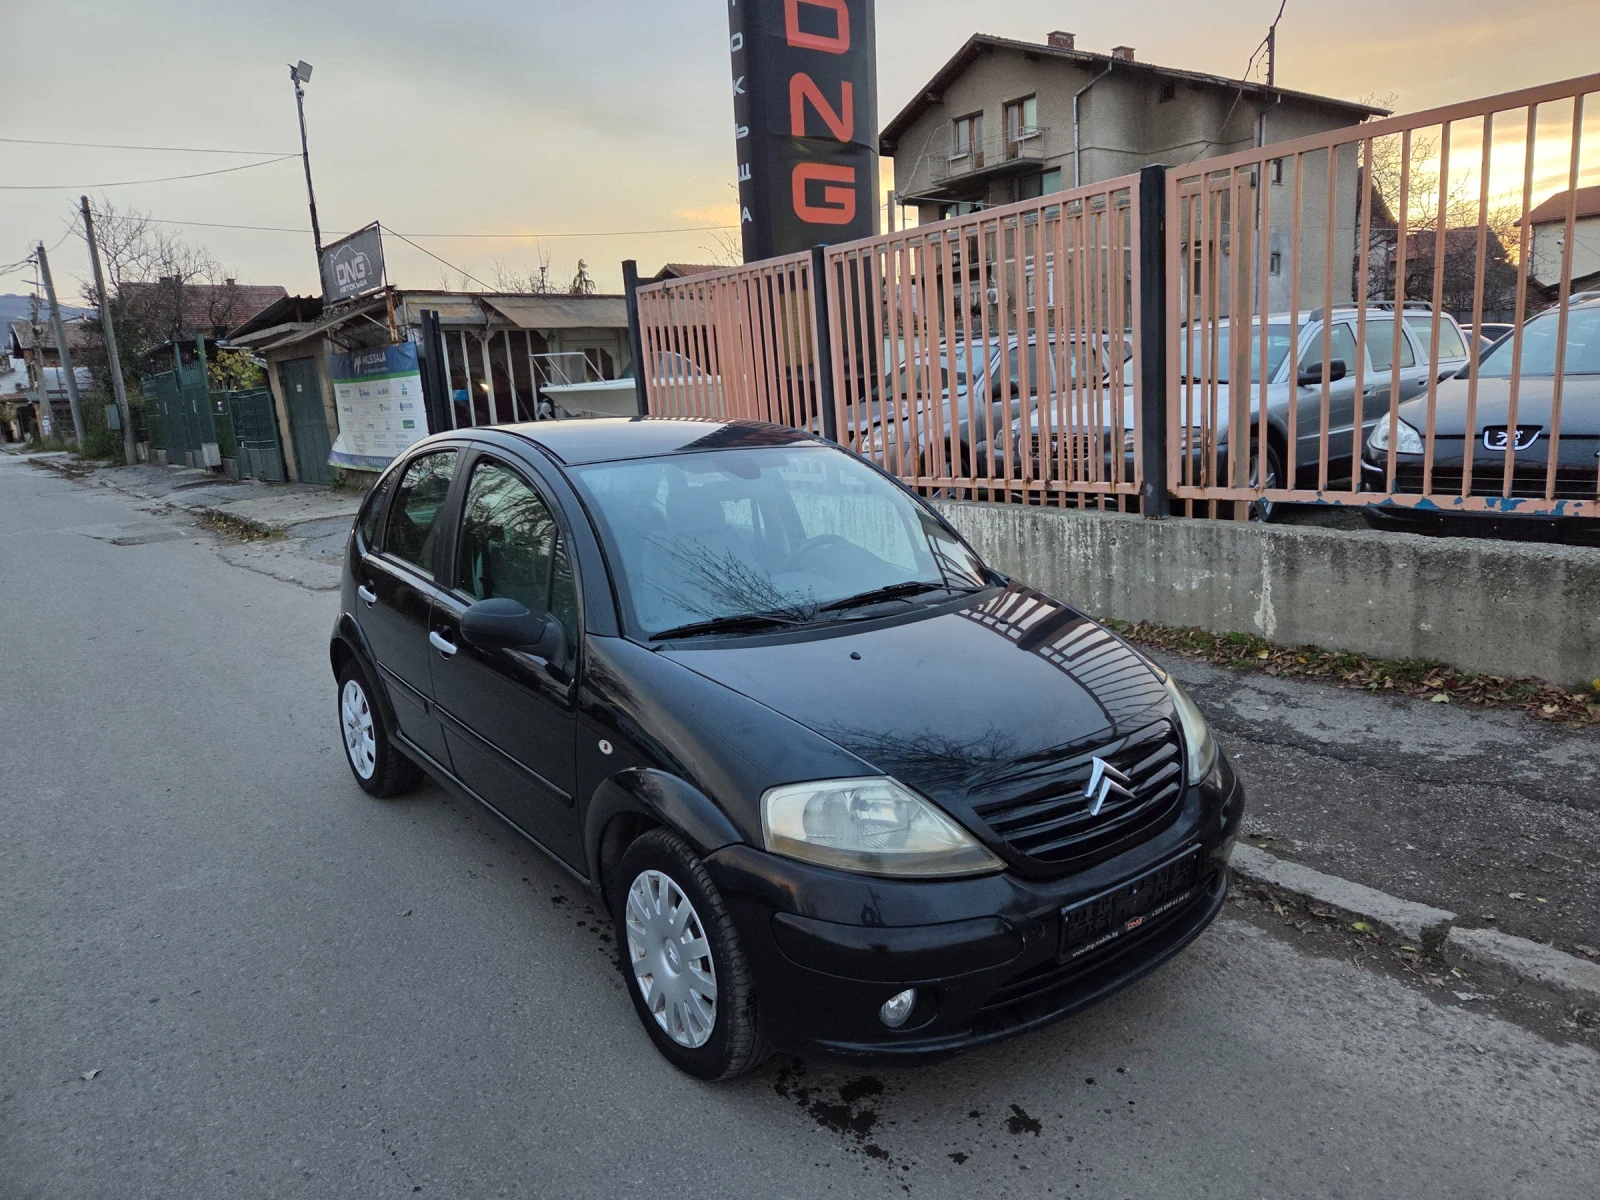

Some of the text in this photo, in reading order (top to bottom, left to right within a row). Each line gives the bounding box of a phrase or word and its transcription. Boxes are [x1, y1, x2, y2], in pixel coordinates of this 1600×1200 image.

[784, 0, 856, 225] DNG
[336, 255, 366, 286] DNG
[362, 352, 386, 365] MUSSALA
